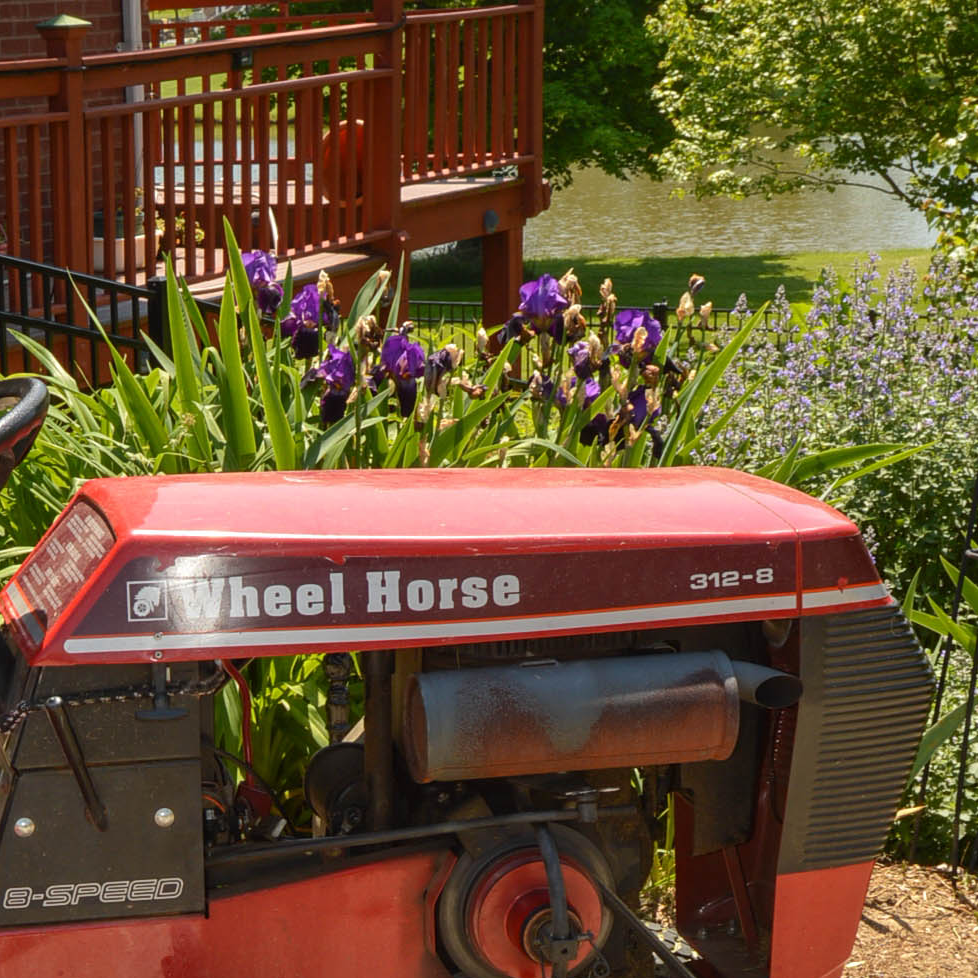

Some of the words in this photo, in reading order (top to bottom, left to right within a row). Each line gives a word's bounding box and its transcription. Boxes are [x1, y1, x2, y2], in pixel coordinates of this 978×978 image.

[180, 573, 345, 617] Wheel
[366, 571, 520, 613] Horse
[689, 568, 774, 590] 312-8
[3, 877, 183, 910] 8-SPEED
